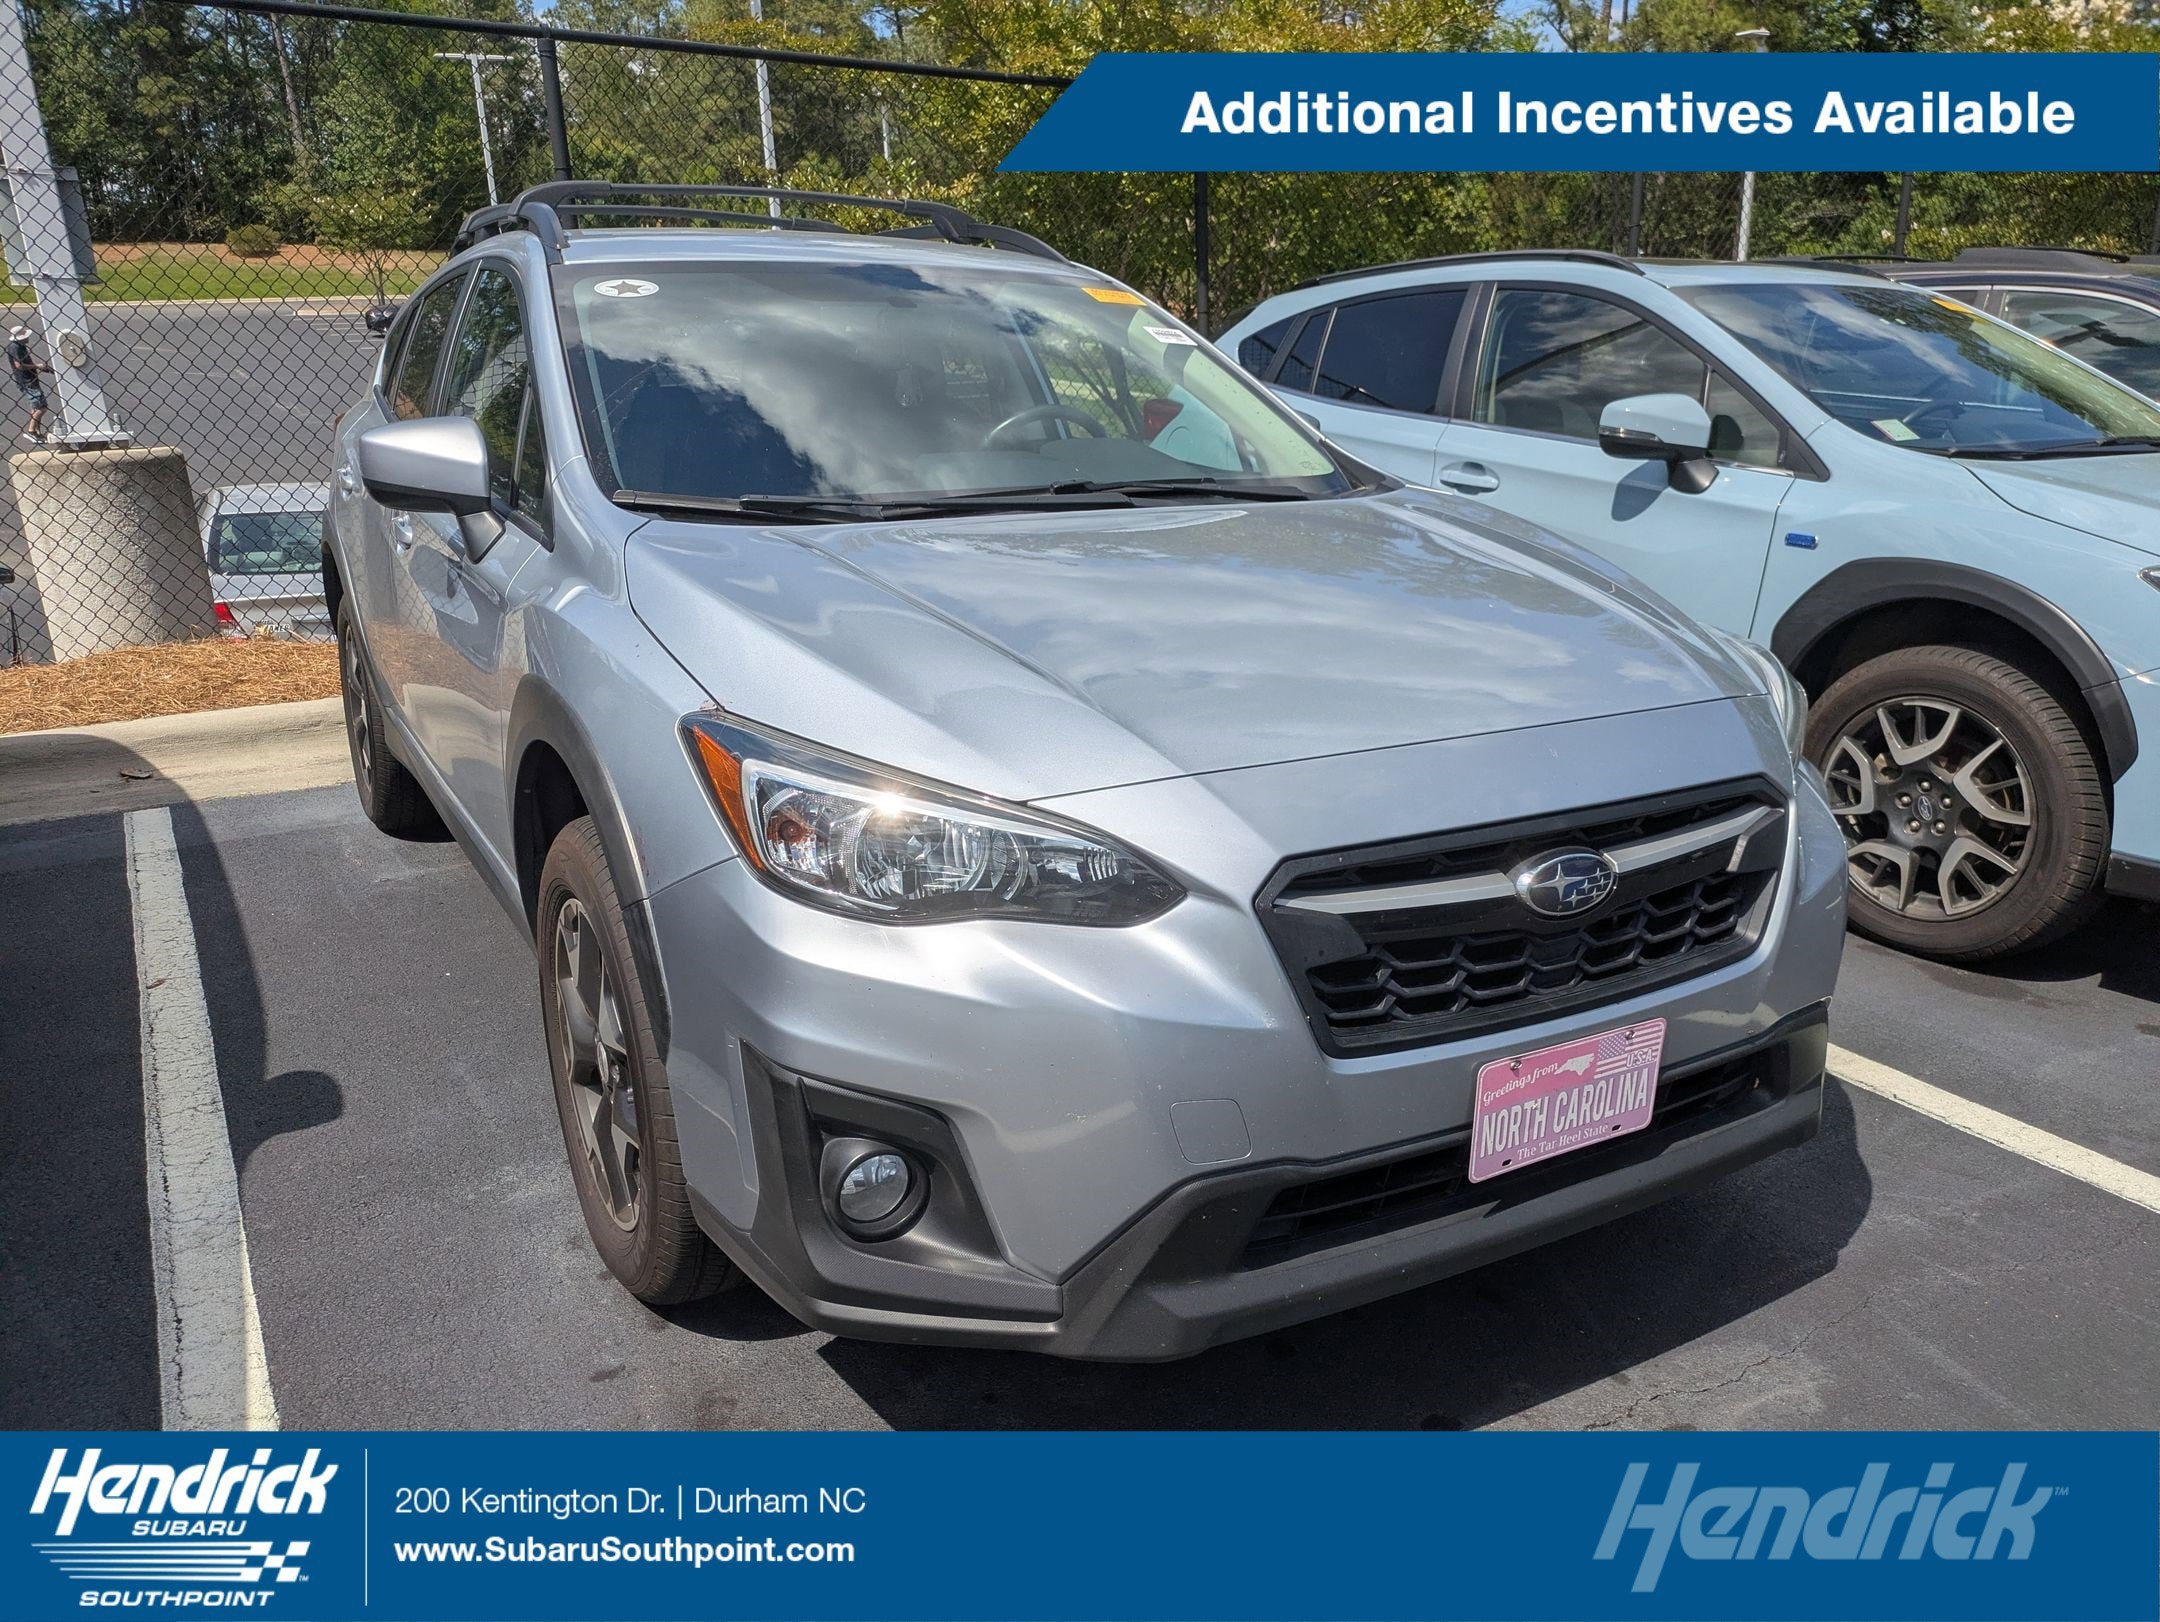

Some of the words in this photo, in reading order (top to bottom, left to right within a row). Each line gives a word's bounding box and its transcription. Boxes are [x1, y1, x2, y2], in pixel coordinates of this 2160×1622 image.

[1626, 1048, 1656, 1068] U.S.A.
[1483, 1074, 1531, 1106] Greetings
[1530, 1062, 1558, 1084] from
[1480, 1096, 1549, 1158] NORTH
[1552, 1067, 1649, 1133] CAROLINA
[1517, 1146, 1537, 1160] The
[1538, 1140, 1556, 1155] Tar
[1559, 1129, 1581, 1146] Heel
[1583, 1123, 1609, 1140] State
